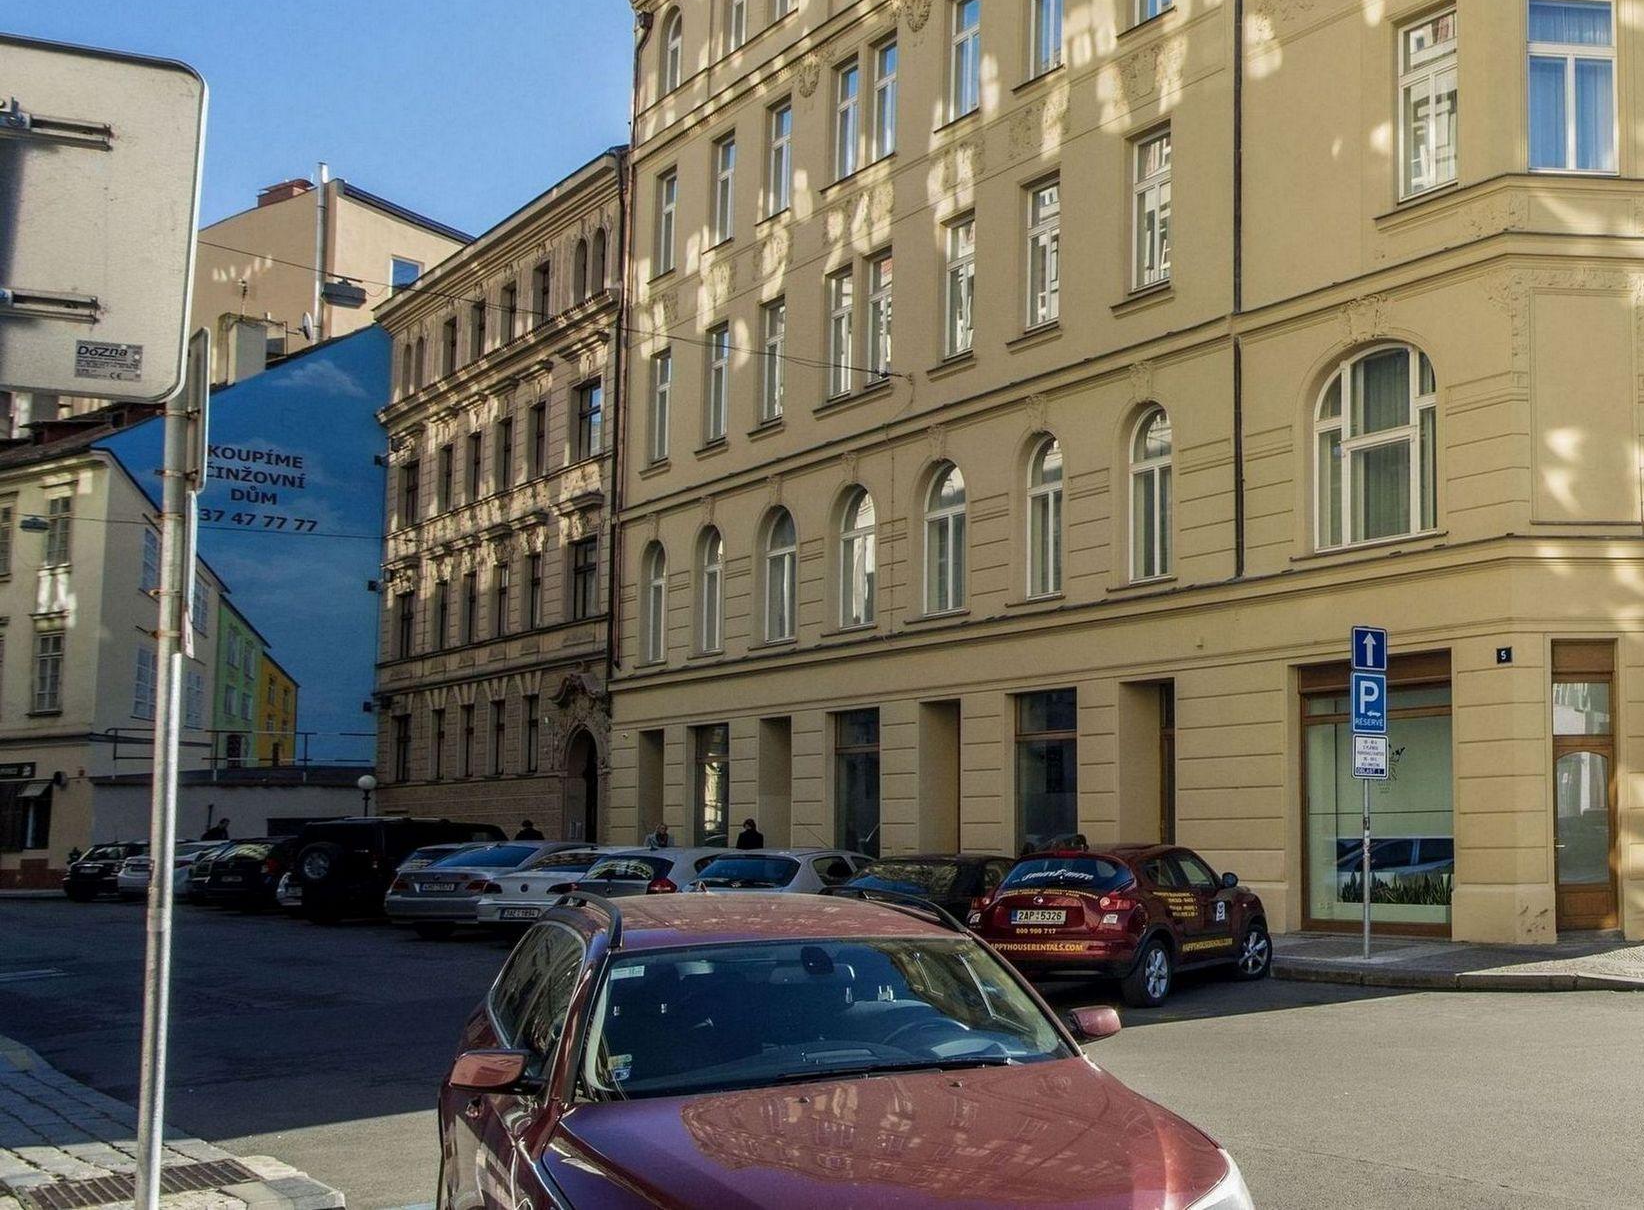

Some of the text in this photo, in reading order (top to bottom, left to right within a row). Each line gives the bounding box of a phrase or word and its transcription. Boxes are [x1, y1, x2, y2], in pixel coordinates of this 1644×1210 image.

[207, 444, 303, 469] KOUPÍME
[231, 486, 277, 505] DŮM
[199, 508, 318, 532] 37 47 77 77
[1500, 650, 1506, 660] 5
[1360, 680, 1379, 714] P
[1018, 911, 1062, 921] 2AP 5326
[990, 943, 1083, 952] APPYHOUSERENTALS.COM
